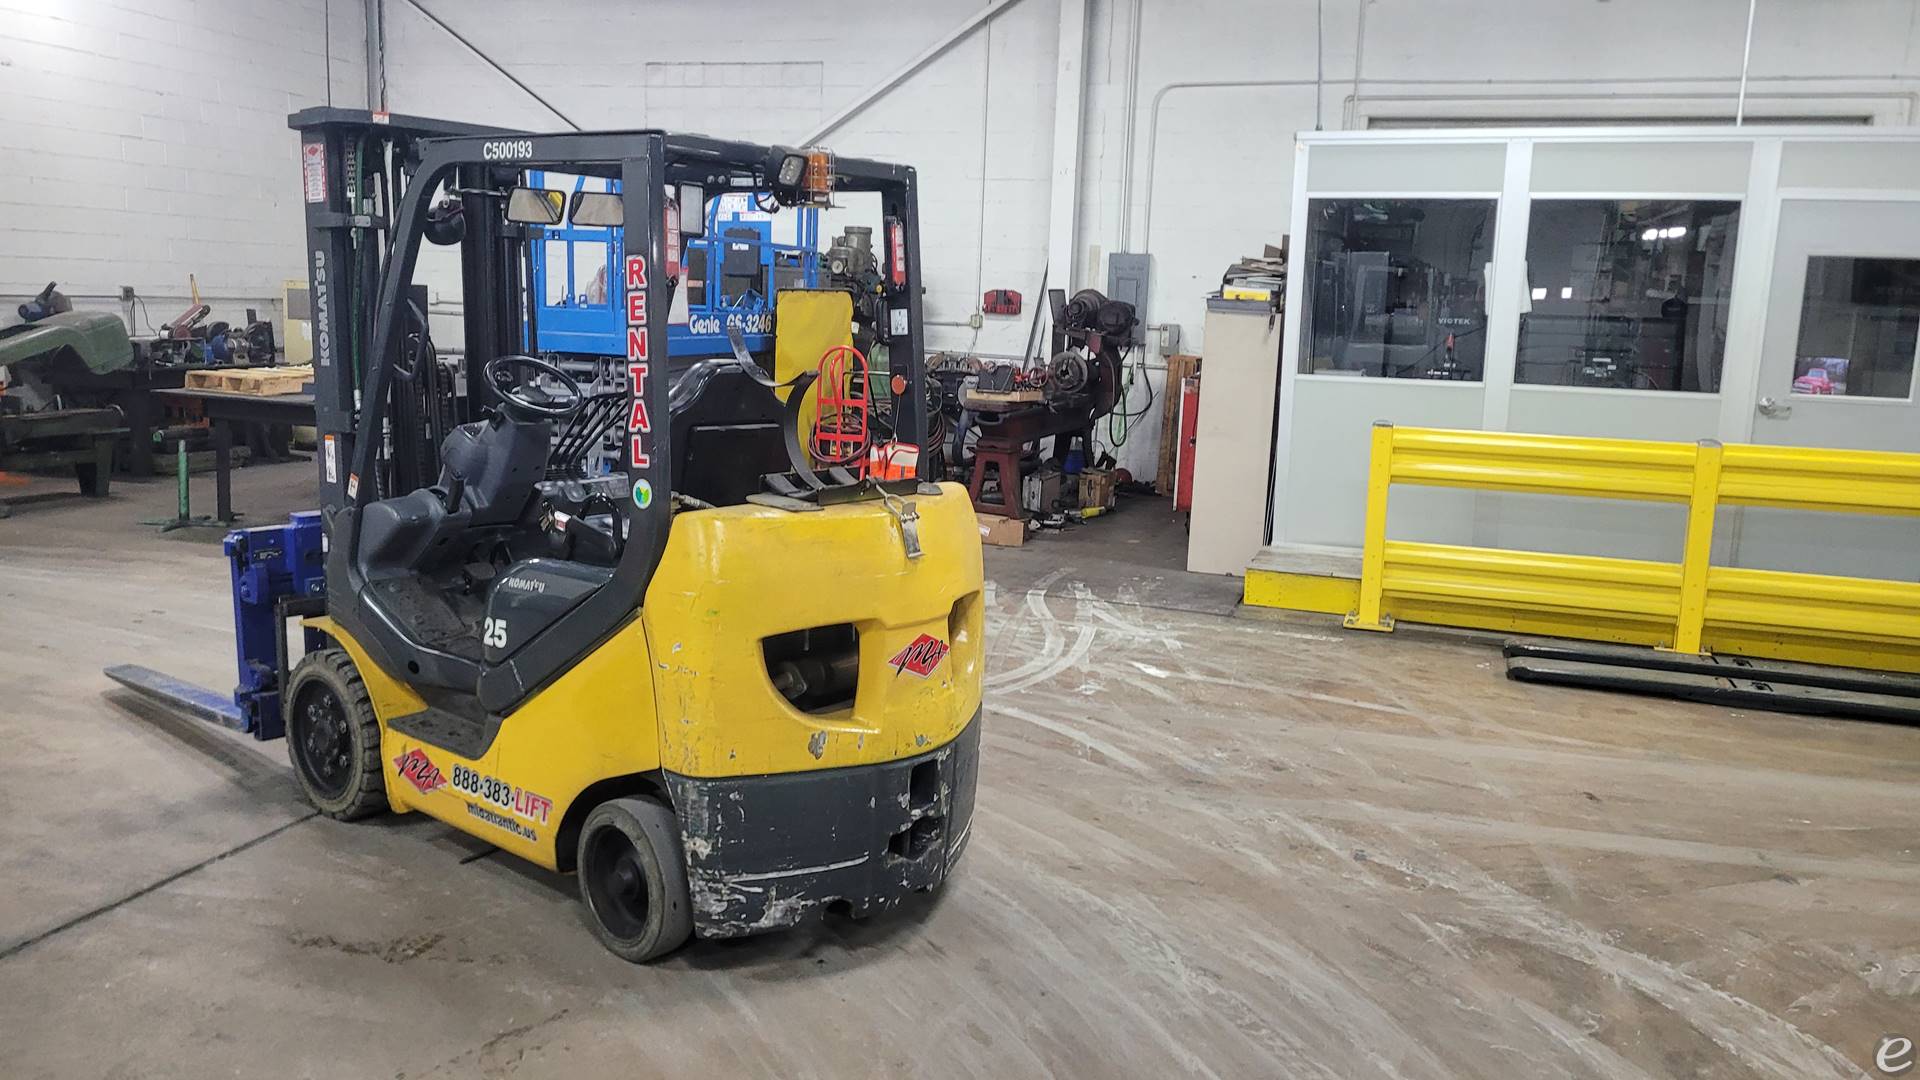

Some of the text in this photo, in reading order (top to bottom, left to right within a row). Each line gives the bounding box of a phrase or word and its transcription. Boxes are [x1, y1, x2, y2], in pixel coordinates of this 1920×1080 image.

[483, 140, 533, 160] C500193
[314, 249, 330, 367] KOMATSU
[689, 313, 720, 334] Genie
[626, 255, 651, 468] RENTAL
[508, 577, 546, 594] KOMATSU
[483, 616, 507, 649] 25
